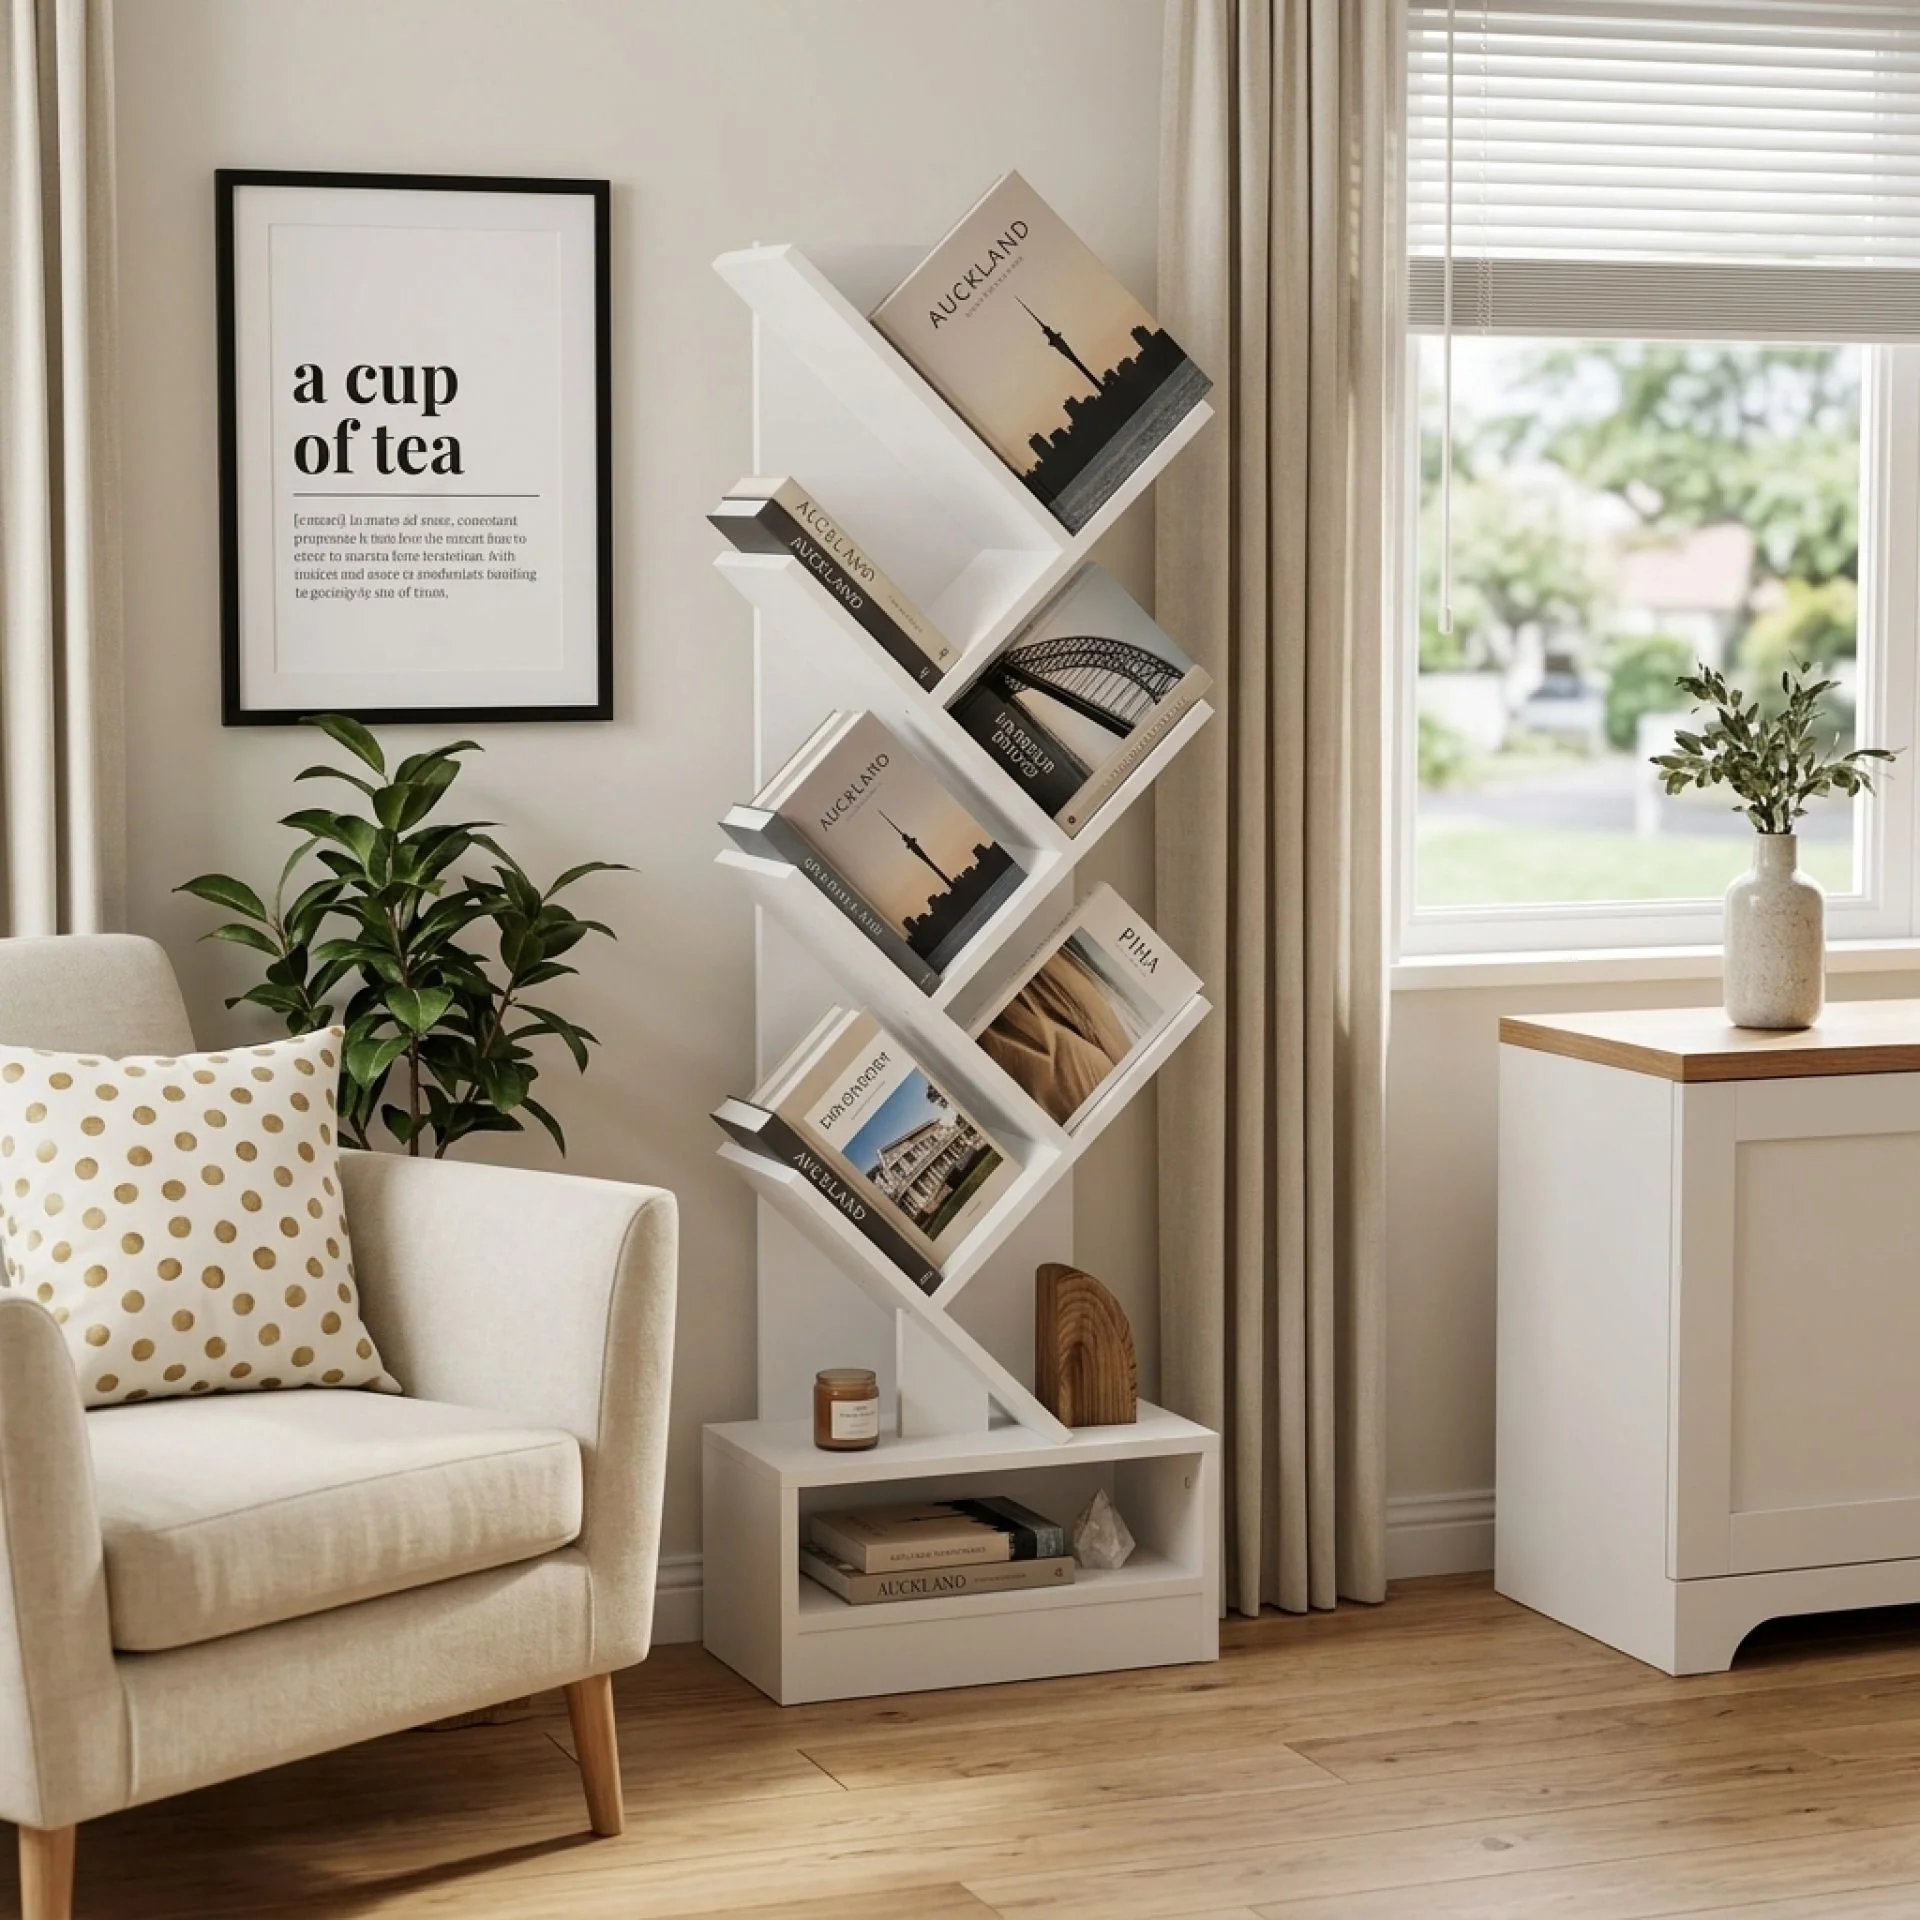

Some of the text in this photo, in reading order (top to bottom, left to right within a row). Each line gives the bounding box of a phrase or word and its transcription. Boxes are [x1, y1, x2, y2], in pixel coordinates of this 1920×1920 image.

[929, 220, 1029, 329] AUCKLAND
[293, 363, 459, 417] a cup
[294, 417, 466, 475] of tea
[877, 1574, 967, 1597] AUCKLAND
